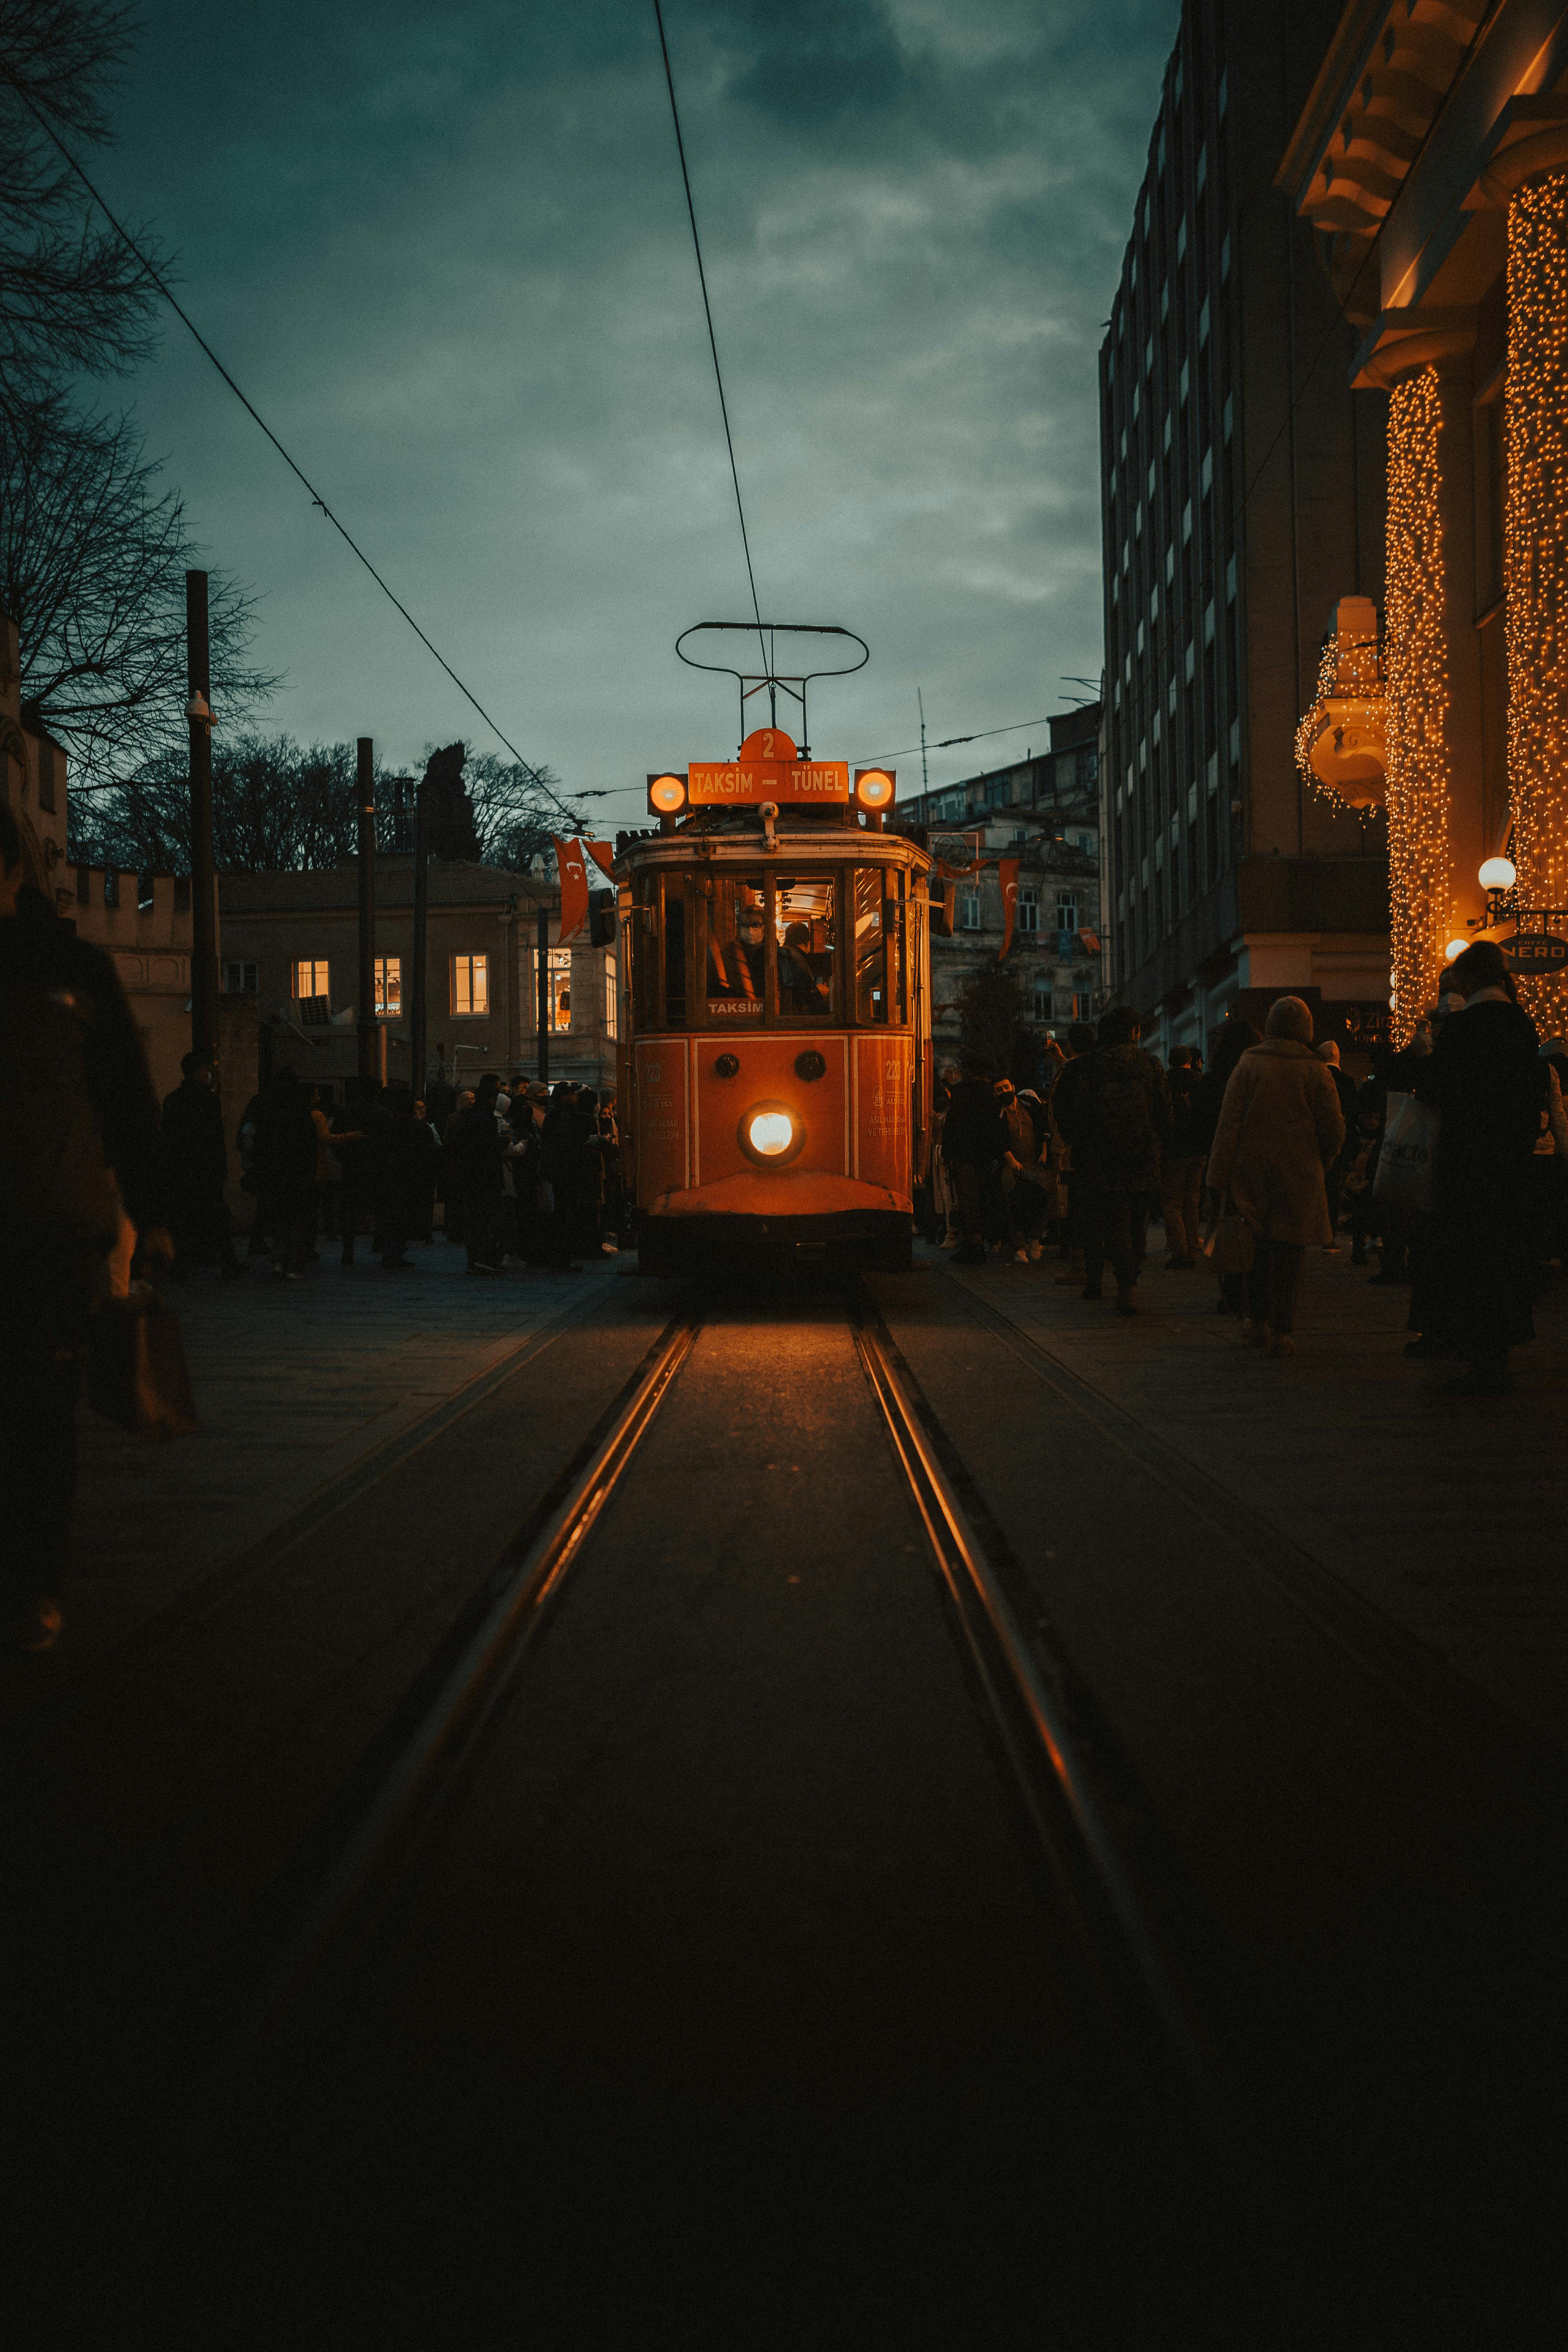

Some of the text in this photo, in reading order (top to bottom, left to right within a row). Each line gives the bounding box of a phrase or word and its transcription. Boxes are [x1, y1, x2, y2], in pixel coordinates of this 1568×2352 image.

[763, 732, 774, 758] 2
[695, 767, 753, 793] TAKSİM
[791, 765, 843, 791] TÜNEL
[1501, 947, 1565, 958] NERO
[708, 1001, 764, 1013] TAKSİM
[886, 1060, 901, 1080] 223
[659, 1119, 678, 1127] YASAK
[868, 1128, 877, 1136] VE
